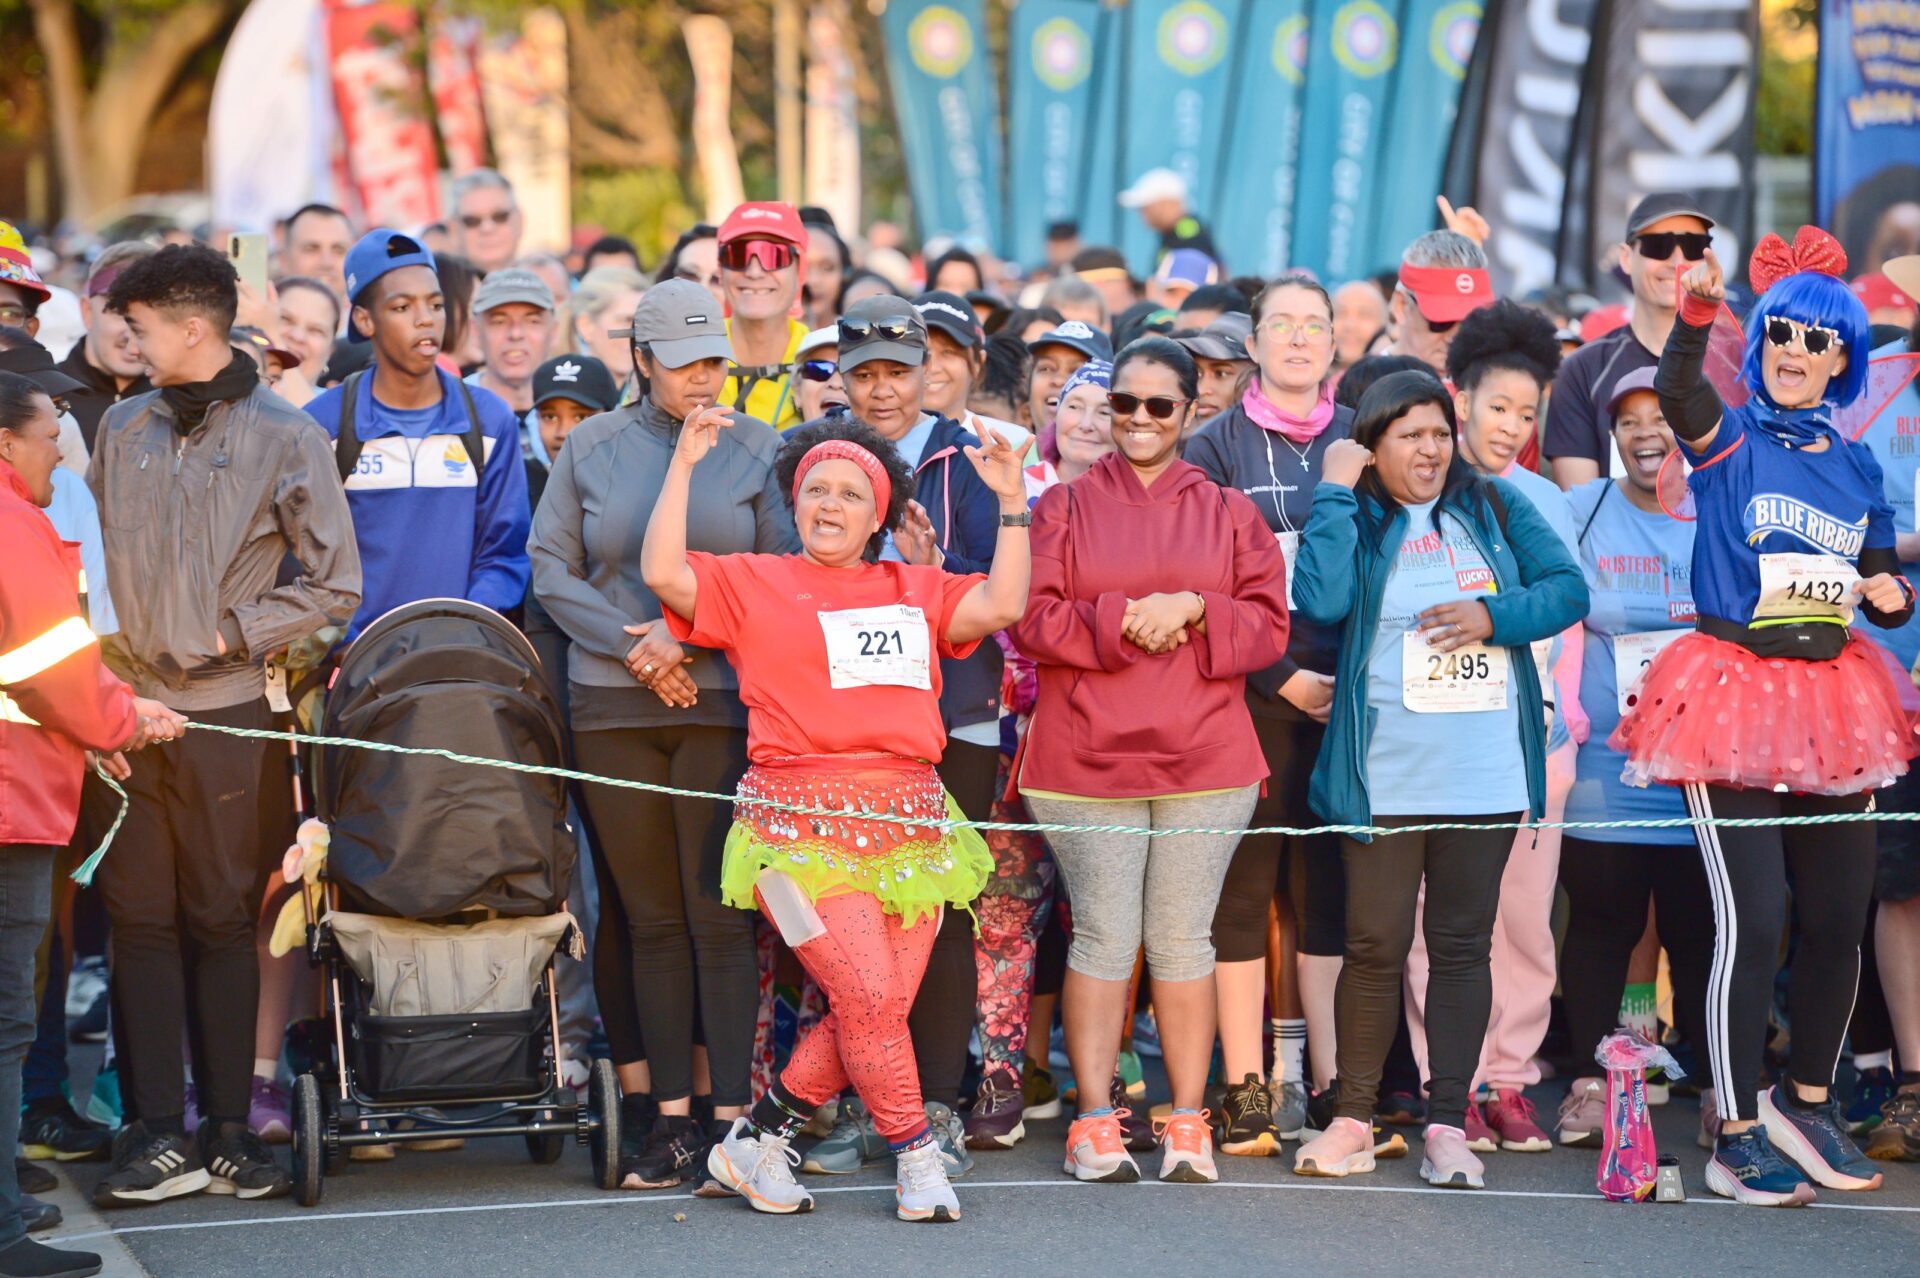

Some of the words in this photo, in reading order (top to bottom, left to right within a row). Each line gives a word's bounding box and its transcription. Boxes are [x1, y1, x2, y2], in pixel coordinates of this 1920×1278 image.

[1889, 436, 1914, 455] FOR
[1755, 499, 1805, 534] BLUE
[1402, 552, 1446, 570] BREAD
[1458, 571, 1489, 588] LUCKY
[1786, 580, 1844, 606] 1432
[857, 629, 904, 656] 221
[1427, 653, 1489, 681] 2495
